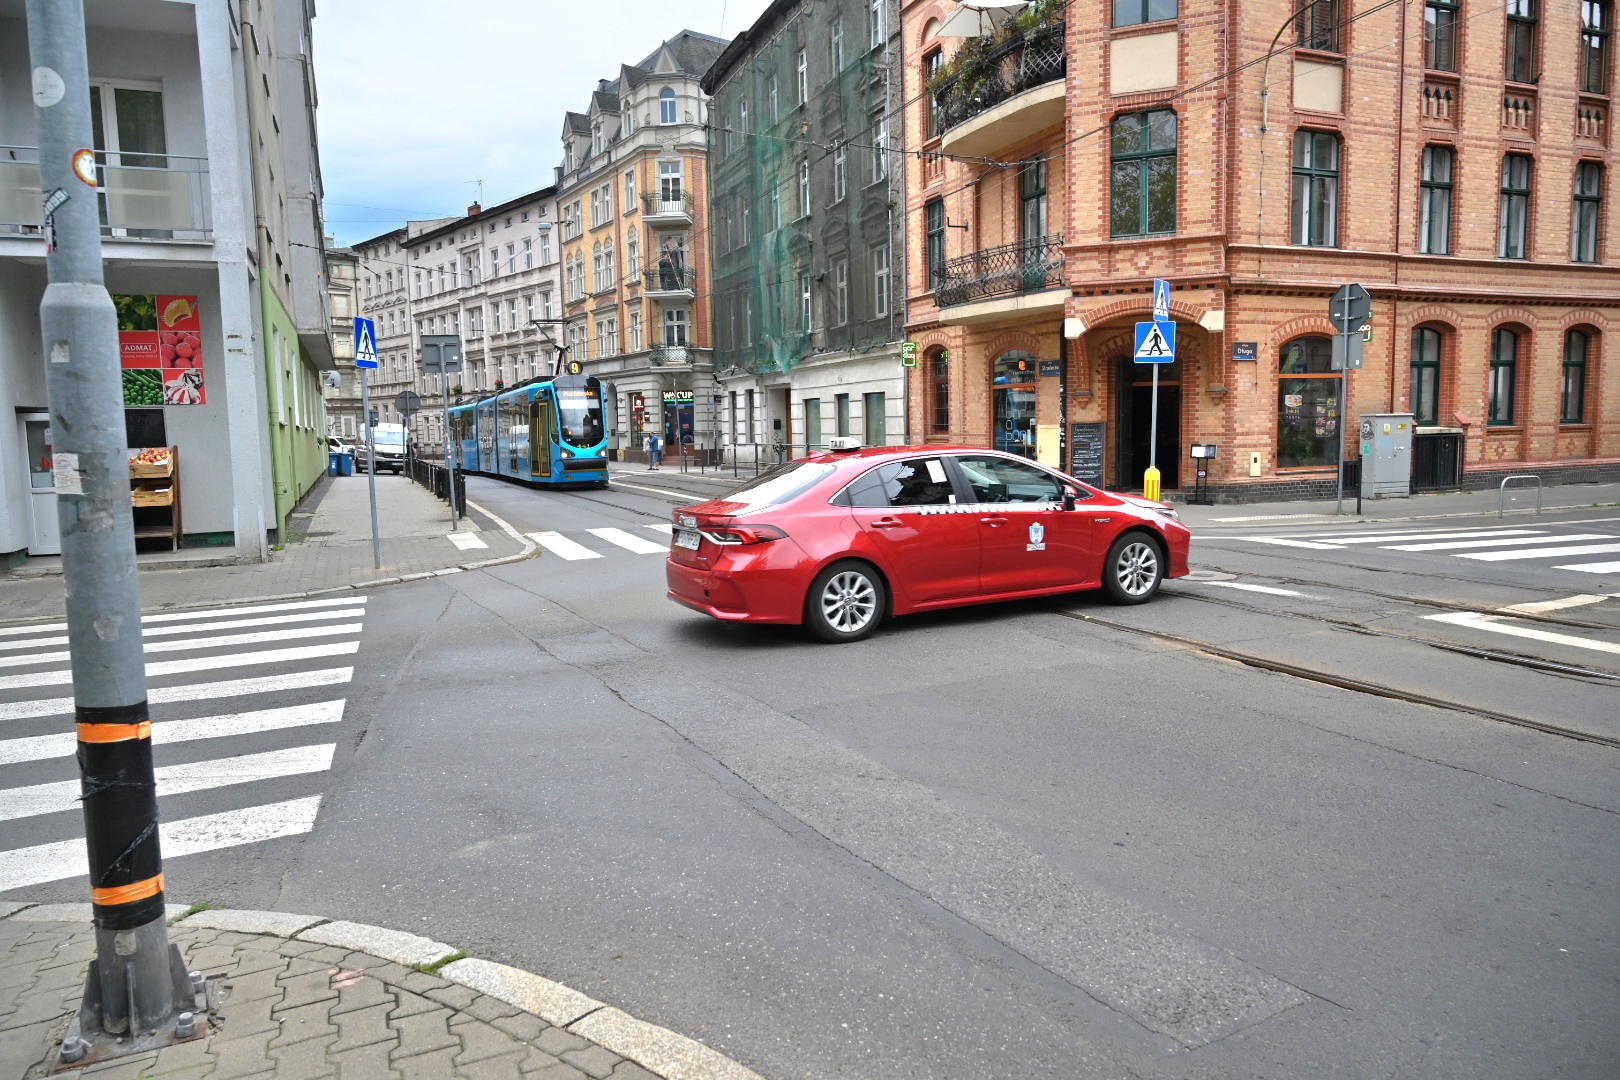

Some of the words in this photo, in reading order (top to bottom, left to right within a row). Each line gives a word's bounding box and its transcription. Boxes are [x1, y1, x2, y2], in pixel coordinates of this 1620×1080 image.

[1237, 347, 1253, 356] Długa
[571, 362, 579, 374] 9
[830, 440, 845, 449] TAXI
